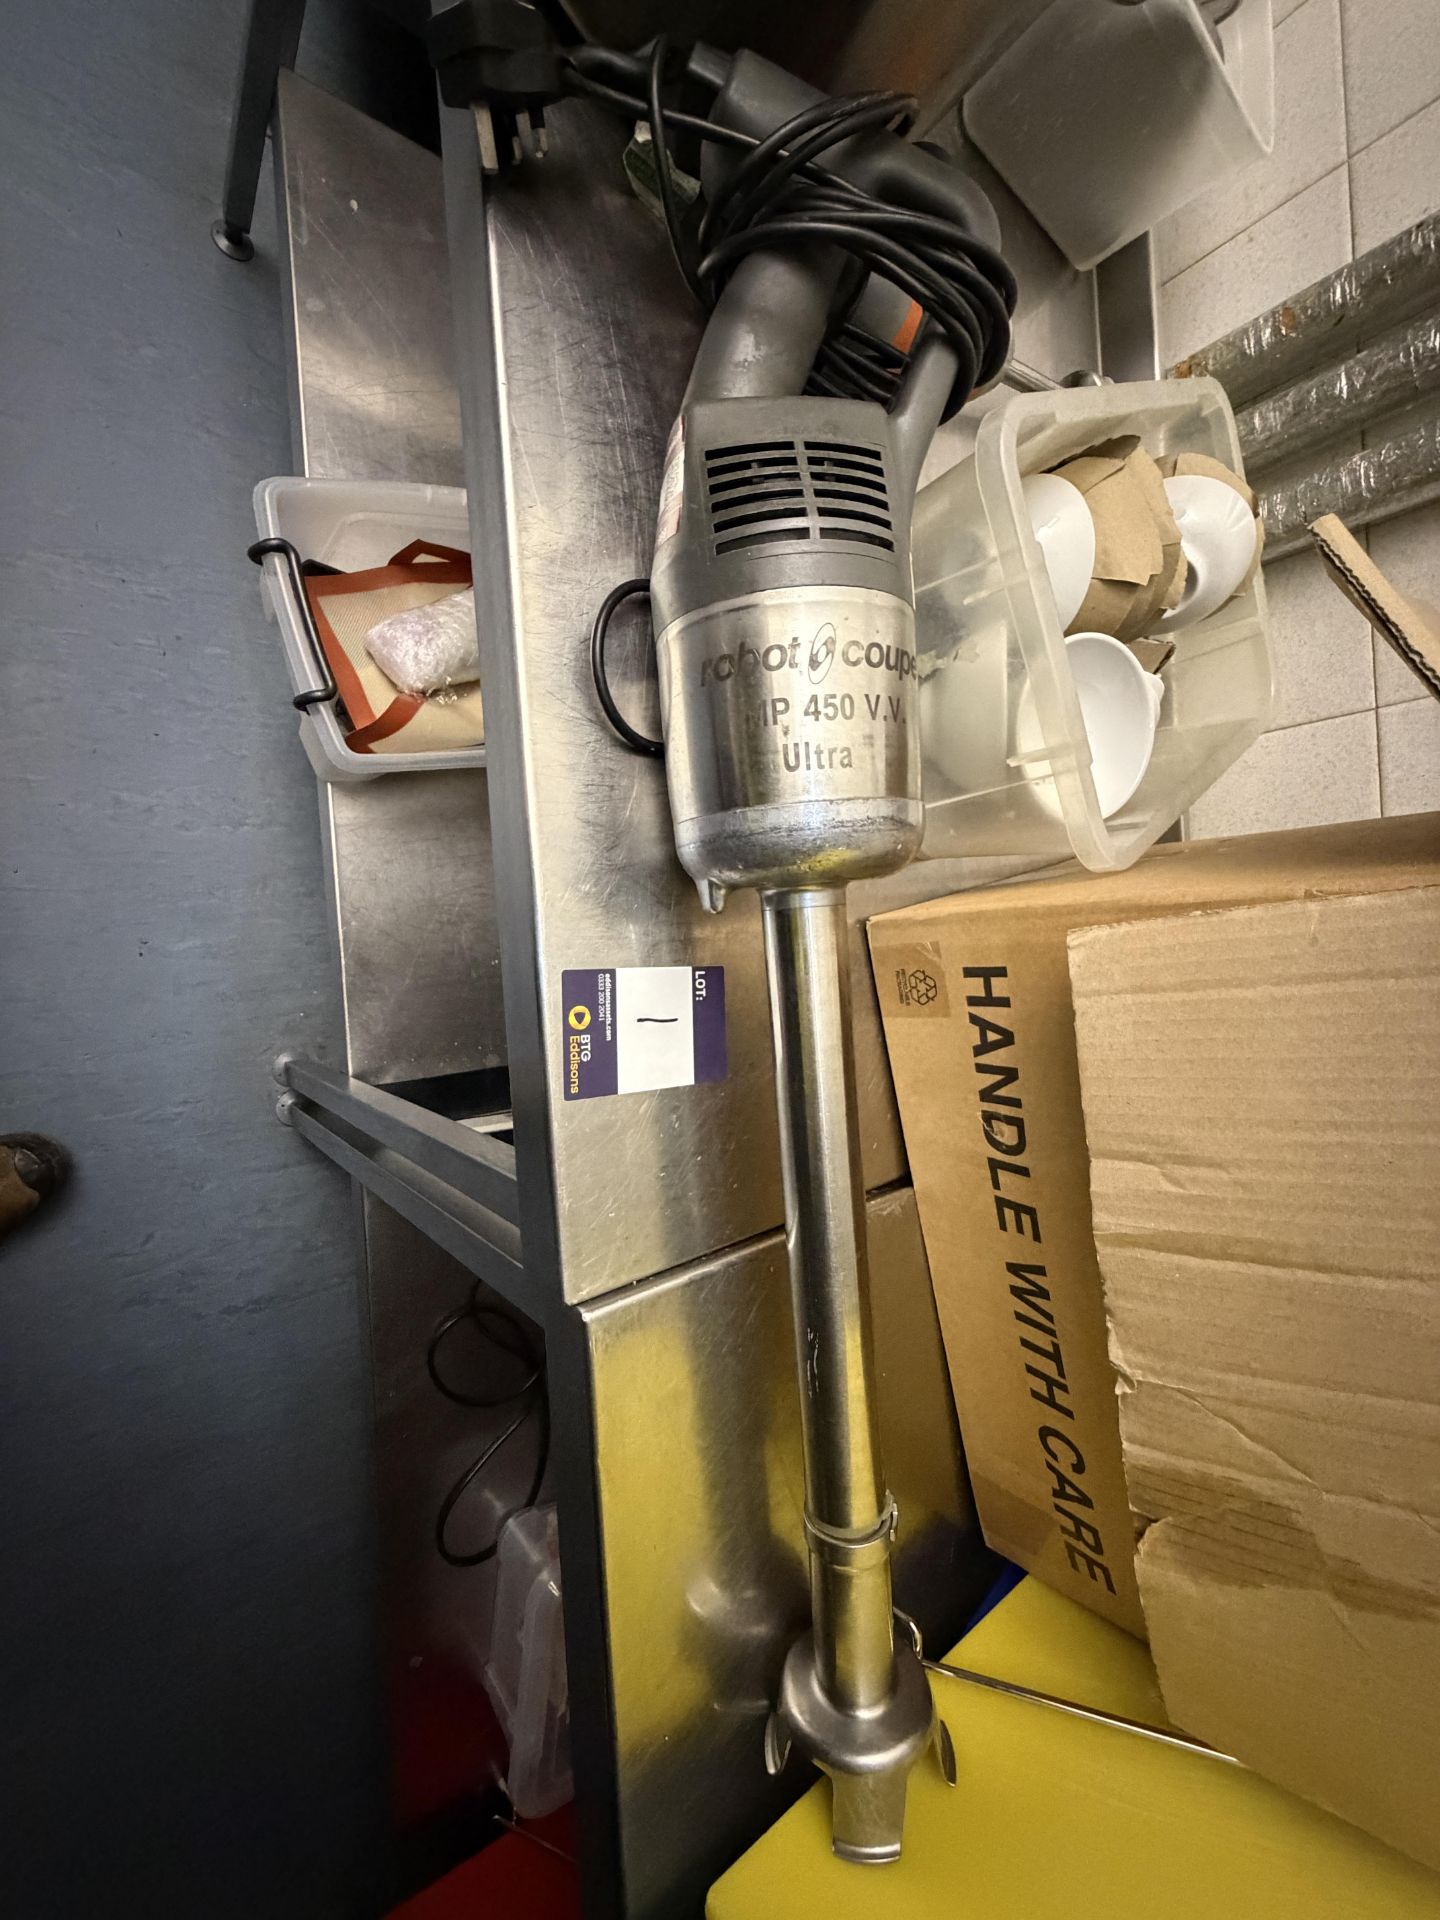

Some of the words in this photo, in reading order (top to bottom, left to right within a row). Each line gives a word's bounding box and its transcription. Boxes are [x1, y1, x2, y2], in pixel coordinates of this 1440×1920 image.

[701, 637, 800, 686] robot
[804, 693, 855, 722] 450
[864, 693, 906, 725] V.V.
[782, 742, 853, 773] Ultra
[695, 971, 706, 1001] LOT:
[569, 1035, 581, 1094] Eddisons
[580, 1034, 591, 1062] BTG
[963, 966, 1042, 1243] HANDLE
[1006, 1261, 1074, 1419] WITH
[1039, 1426, 1117, 1595] CARE
